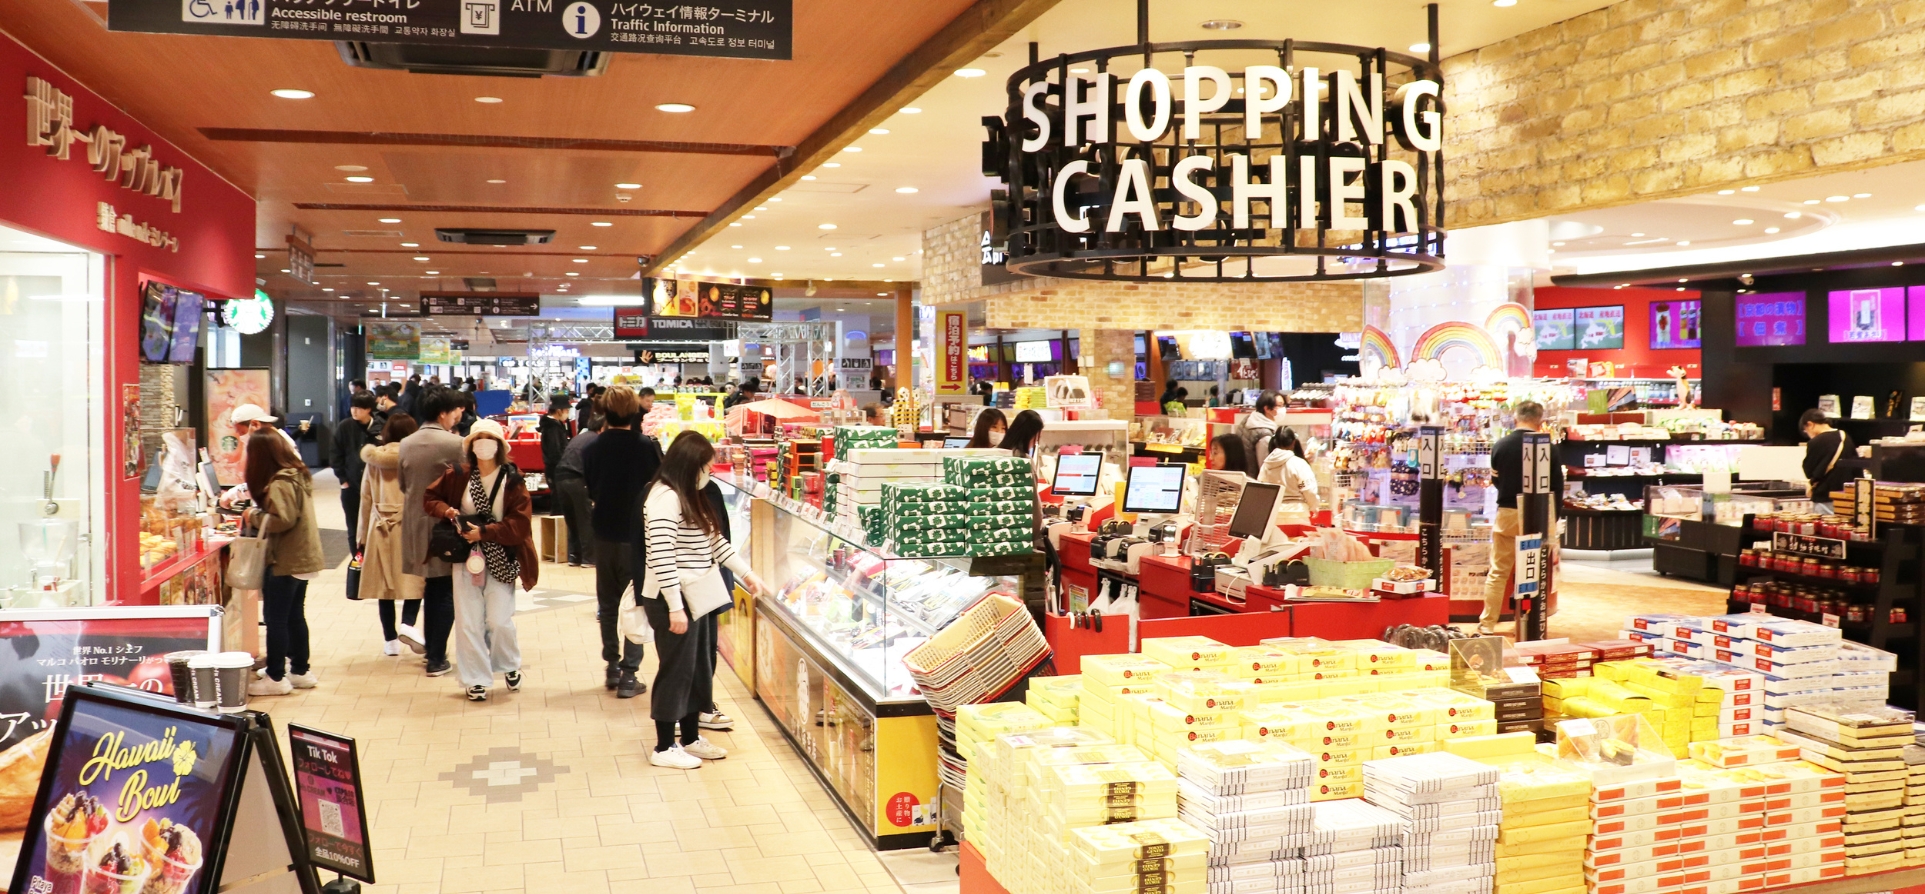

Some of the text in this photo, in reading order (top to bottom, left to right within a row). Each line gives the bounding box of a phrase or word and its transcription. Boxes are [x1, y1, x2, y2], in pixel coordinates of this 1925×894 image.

[271, 7, 407, 24] Accessible restroom
[511, 0, 552, 13] ATM
[611, 3, 775, 24] ハイウェイ情報ターミナル
[394, 26, 428, 37] 교통약자
[430, 27, 456, 38] 화장실
[611, 19, 724, 35] Traffic Information
[610, 32, 775, 50] 交通路况查询平台 고속도로 정보 터미널
[1021, 65, 1442, 152] SHOPPING
[1052, 154, 1419, 234] CASHIER
[618, 315, 647, 329] トミカ
[652, 319, 693, 329] TOMICA
[1578, 310, 1594, 319] 北海道
[1422, 437, 1433, 476] 入口
[1523, 446, 1531, 489] 入口
[1539, 447, 1549, 490] 入口
[1526, 551, 1536, 580] 出口
[73, 644, 143, 655] 世界 No.1 シェフ
[37, 658, 66, 666] マルコ
[215, 678, 223, 704] CREAM
[79, 726, 177, 787] Hawaii
[307, 744, 338, 764] Tik Tok
[298, 757, 347, 780] フォローしてね
[115, 771, 182, 824] Bowl
[315, 846, 360, 869] 全品10%OFF
[31, 875, 53, 893] Pitaya
